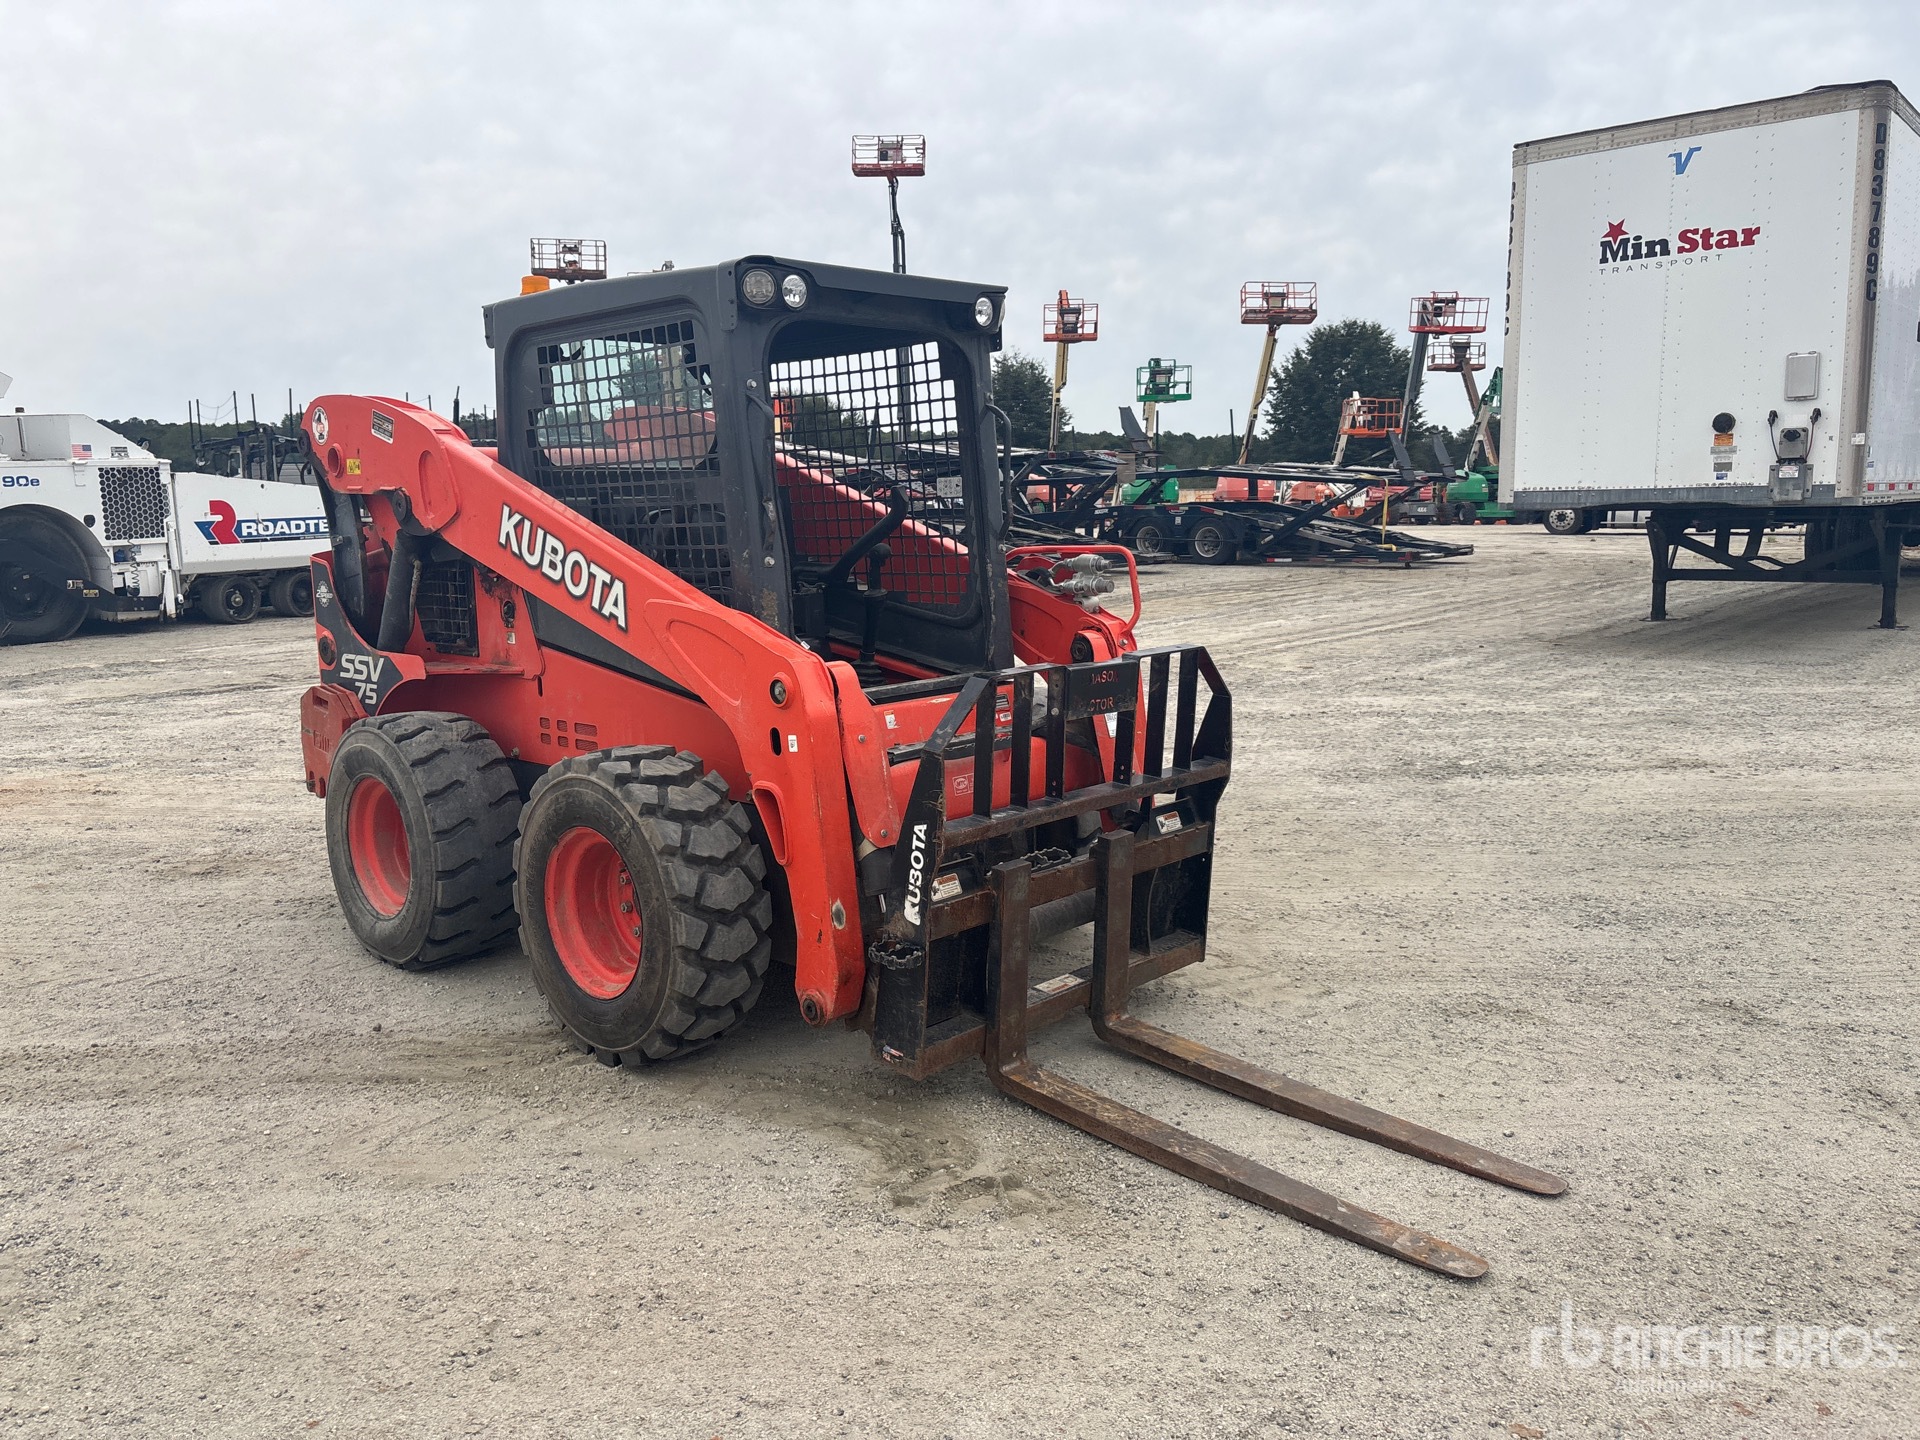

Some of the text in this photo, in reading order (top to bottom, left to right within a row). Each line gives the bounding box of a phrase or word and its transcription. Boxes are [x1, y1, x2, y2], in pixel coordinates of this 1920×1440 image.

[1865, 122, 1887, 302] D83789C
[1599, 226, 1761, 264] Min Star
[1599, 253, 1723, 275] TRANSPORT
[2, 476, 40, 487] 90e
[241, 519, 330, 537] ROADTE
[498, 503, 627, 631] KUBOTA
[339, 653, 385, 682] SSV
[355, 682, 378, 705] 75
[904, 824, 927, 925] KUBOTA
